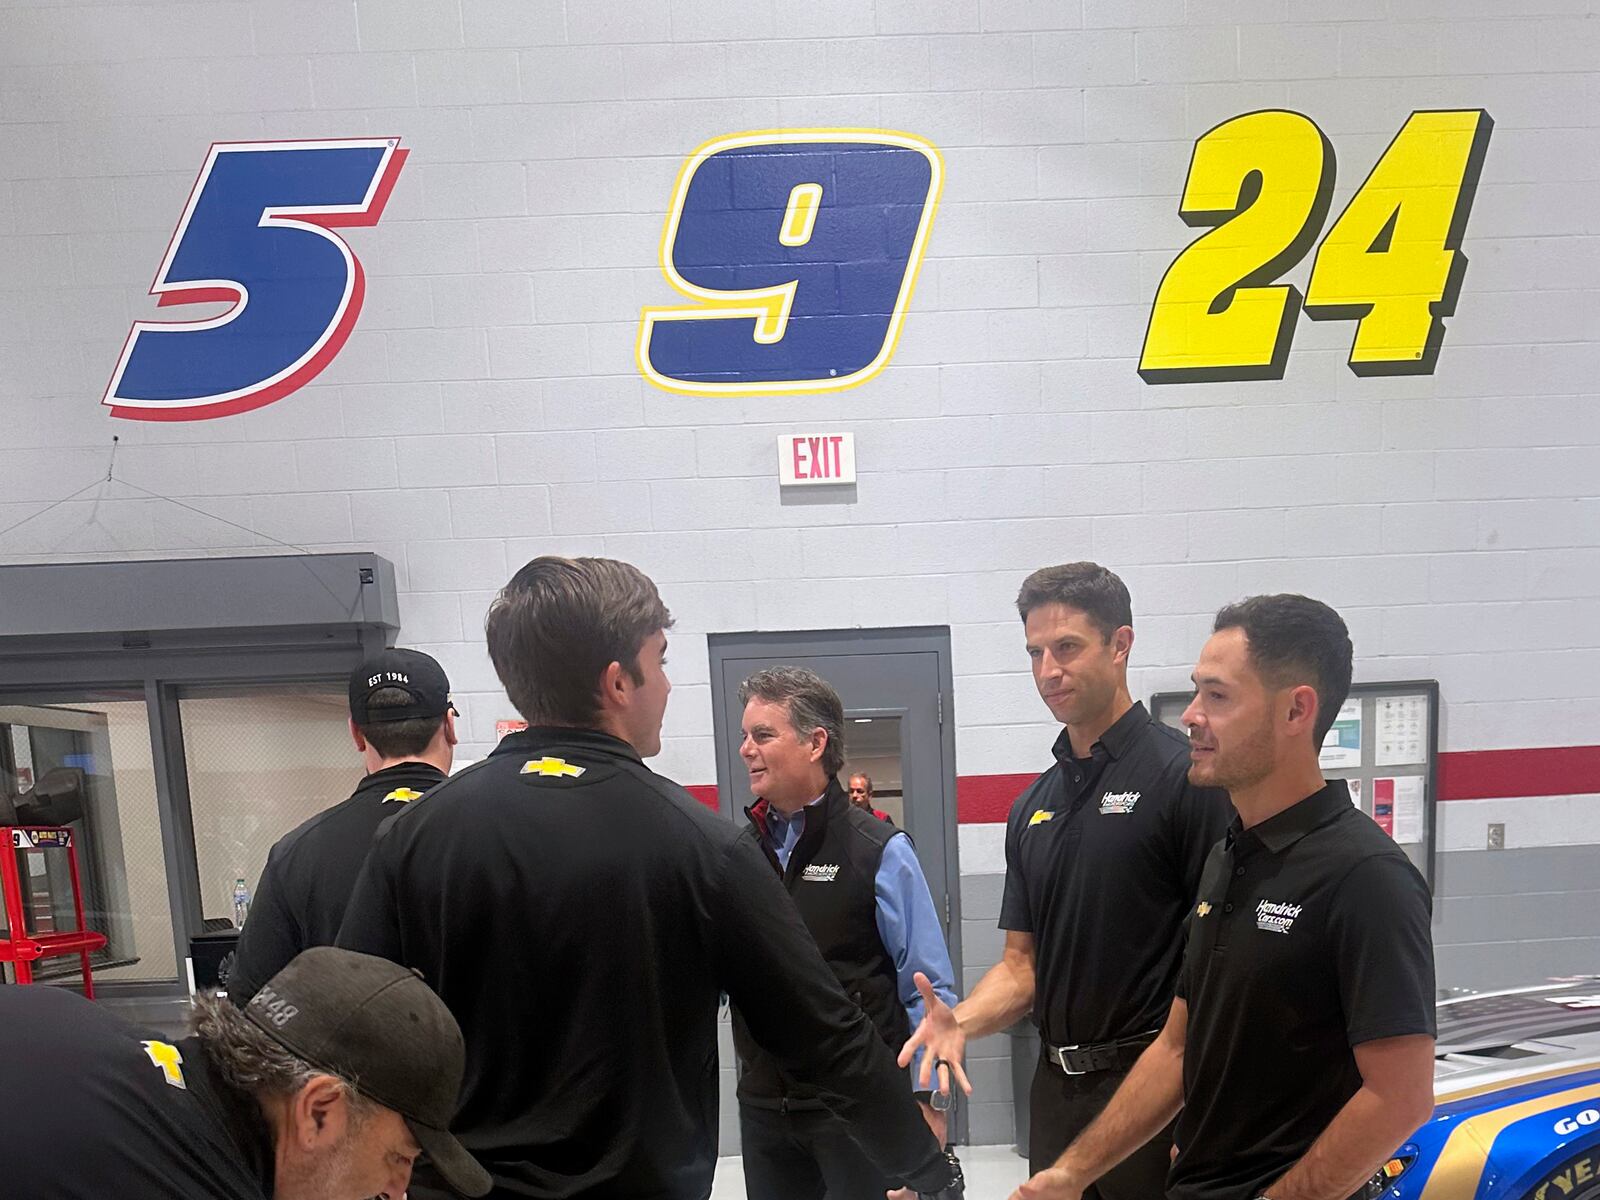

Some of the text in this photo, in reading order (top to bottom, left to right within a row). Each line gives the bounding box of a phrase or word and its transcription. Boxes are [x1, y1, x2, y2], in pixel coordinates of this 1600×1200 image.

[102, 137, 410, 421] 5
[637, 129, 945, 396] 9
[1138, 109, 1494, 385] 24
[792, 436, 843, 478] EXIT
[368, 672, 409, 687] EST 1984
[1256, 899, 1303, 918] Hendrick
